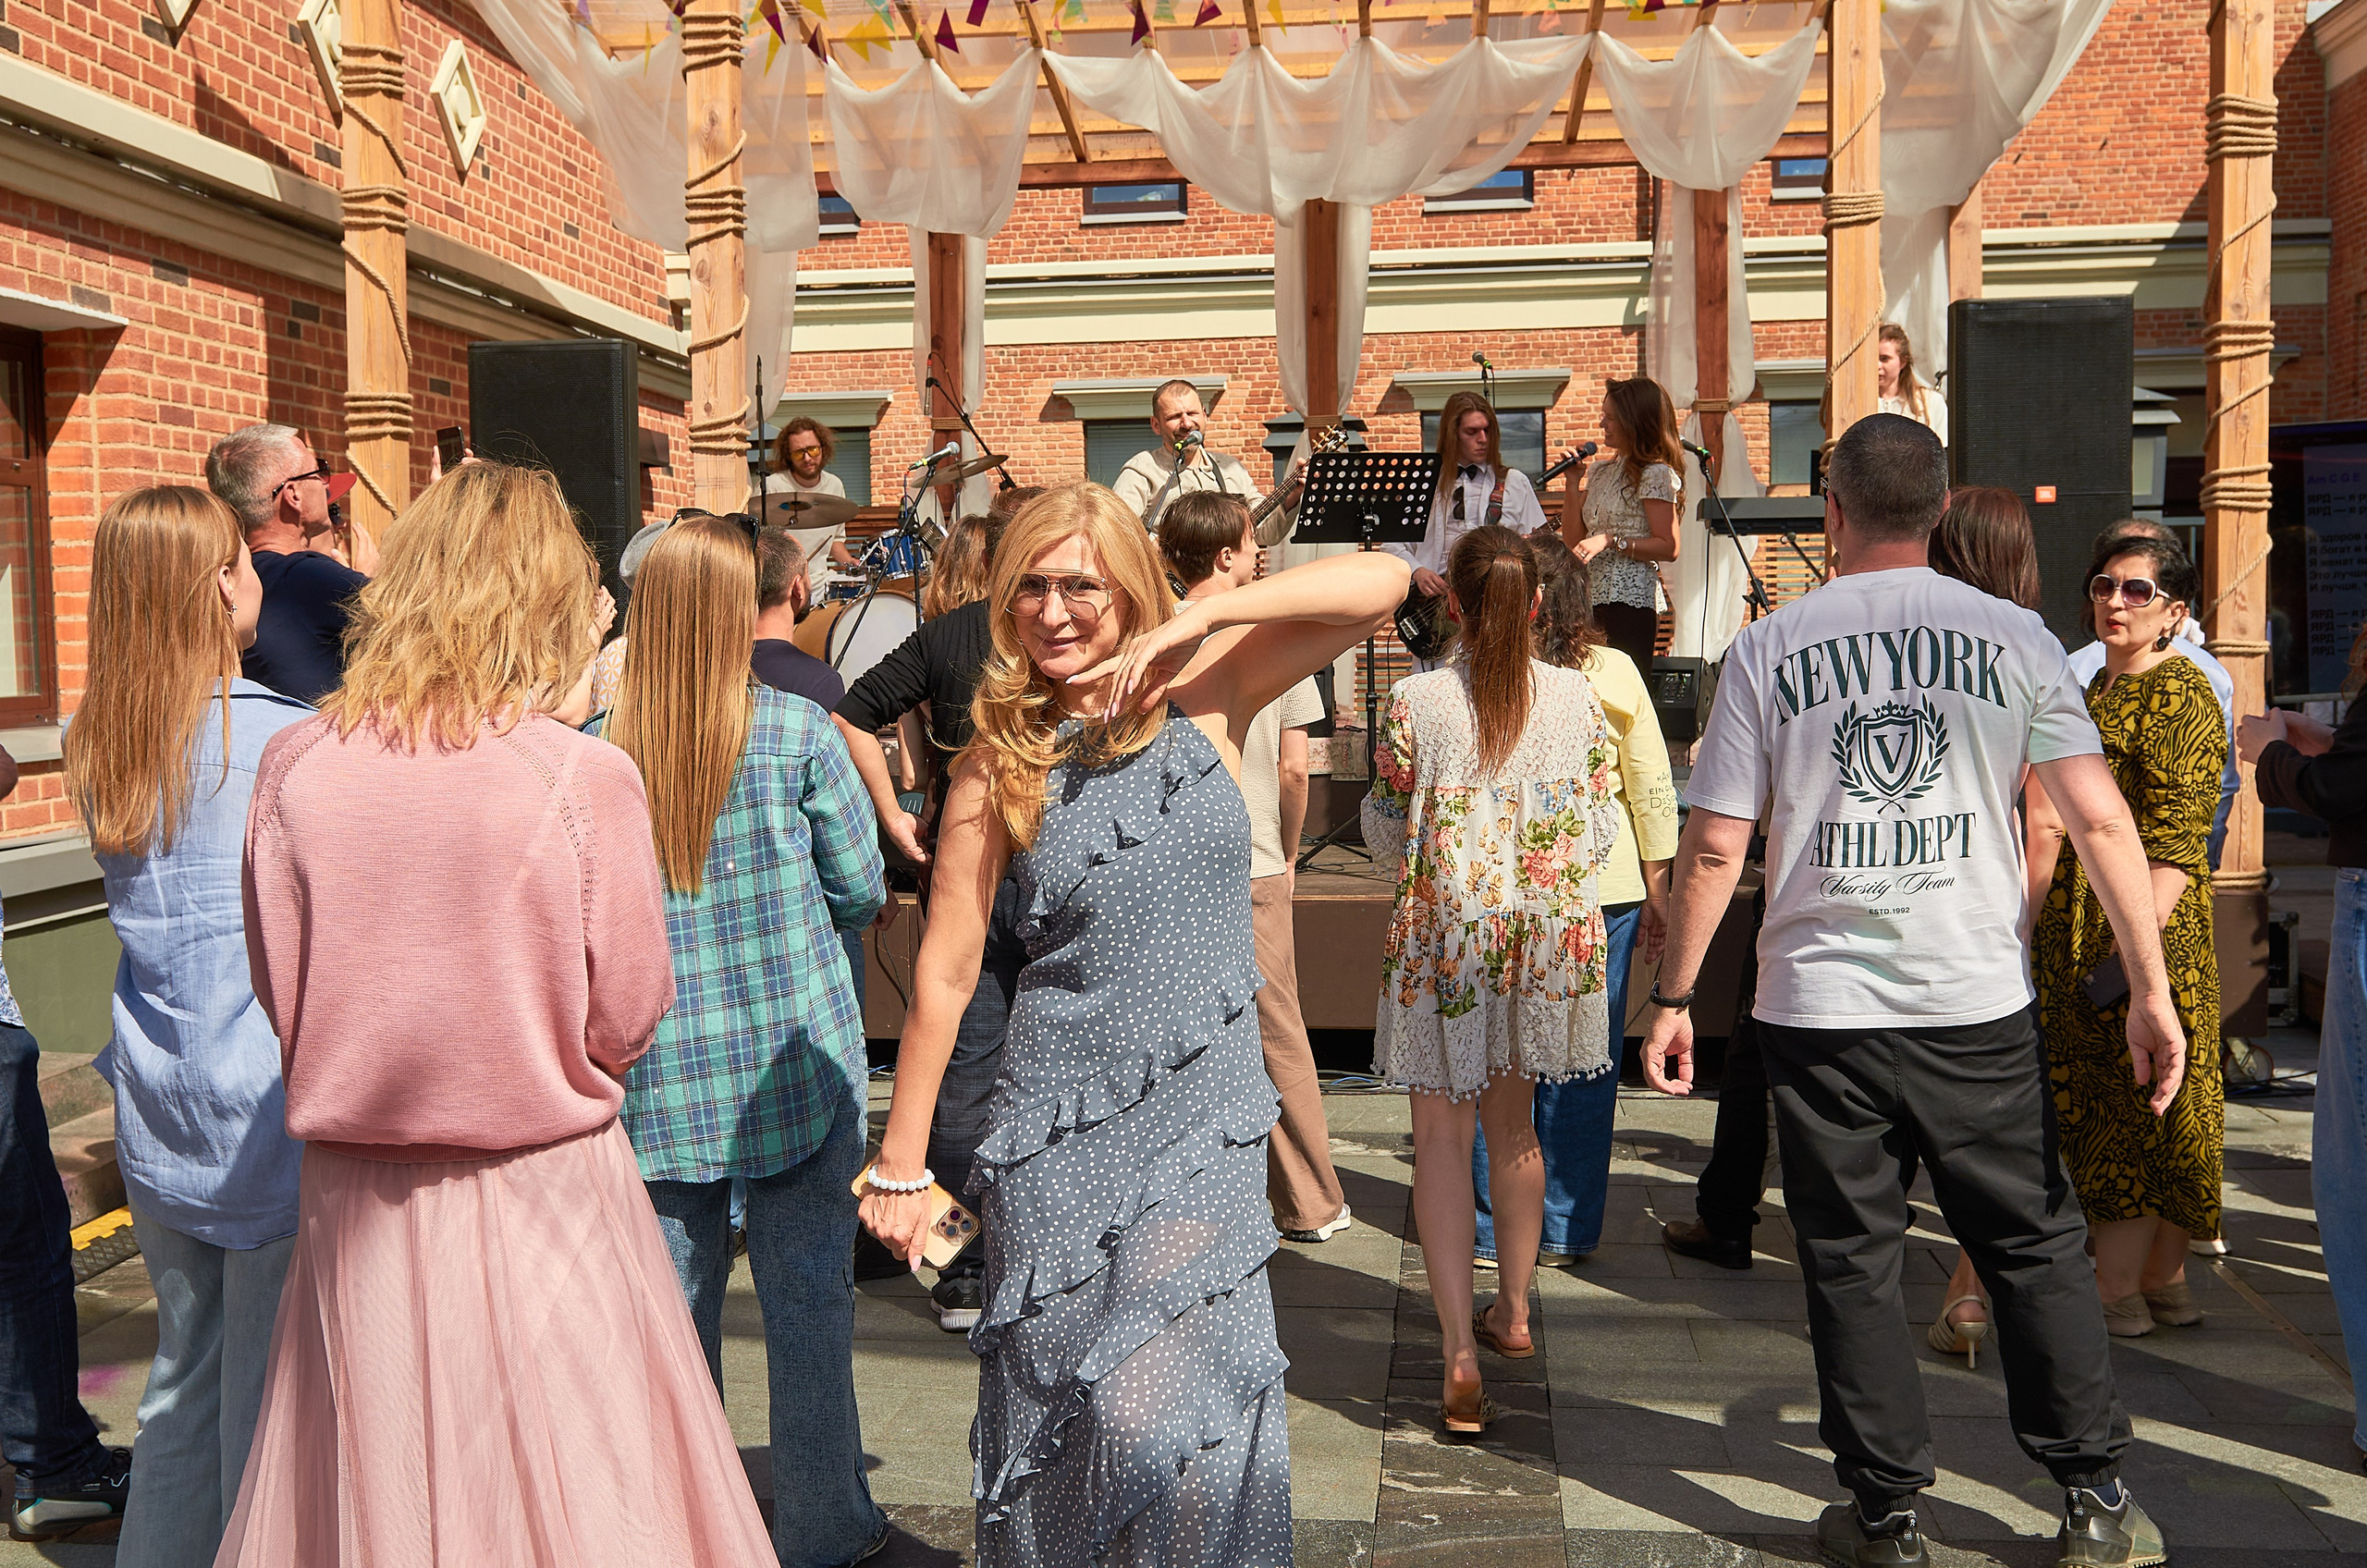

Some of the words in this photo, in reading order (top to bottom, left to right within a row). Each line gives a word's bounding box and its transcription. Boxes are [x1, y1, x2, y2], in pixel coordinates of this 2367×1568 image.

[1872, 731, 1908, 774] V
[1809, 820, 1888, 868] ATHL
[1892, 812, 1976, 867] DEPT
[1820, 875, 1892, 902] Varsity
[1895, 866, 1956, 896] Team
